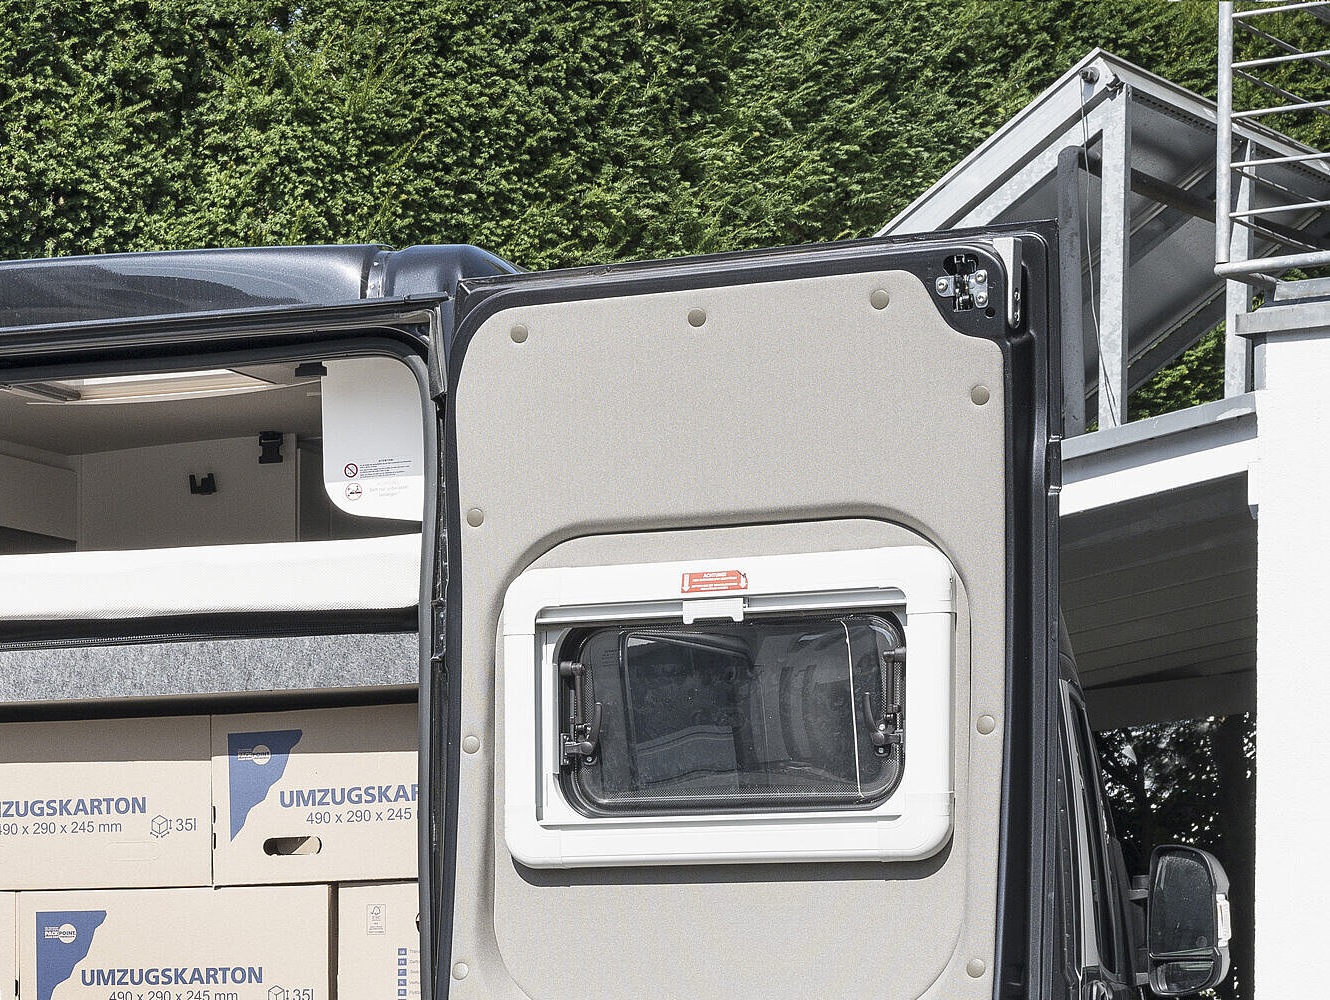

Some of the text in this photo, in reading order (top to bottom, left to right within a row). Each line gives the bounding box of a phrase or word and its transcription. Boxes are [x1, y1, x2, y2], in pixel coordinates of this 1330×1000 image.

[306, 812, 330, 824] 490
[335, 814, 342, 823] x
[347, 810, 371, 822] 290
[376, 812, 383, 821] x
[387, 808, 411, 820] 245
[22, 826, 29, 835] x
[33, 822, 56, 834] 290
[60, 825, 67, 833] x
[71, 821, 94, 833] 245
[99, 823, 121, 832] mm
[82, 967, 262, 986] UMZUGSKARTON
